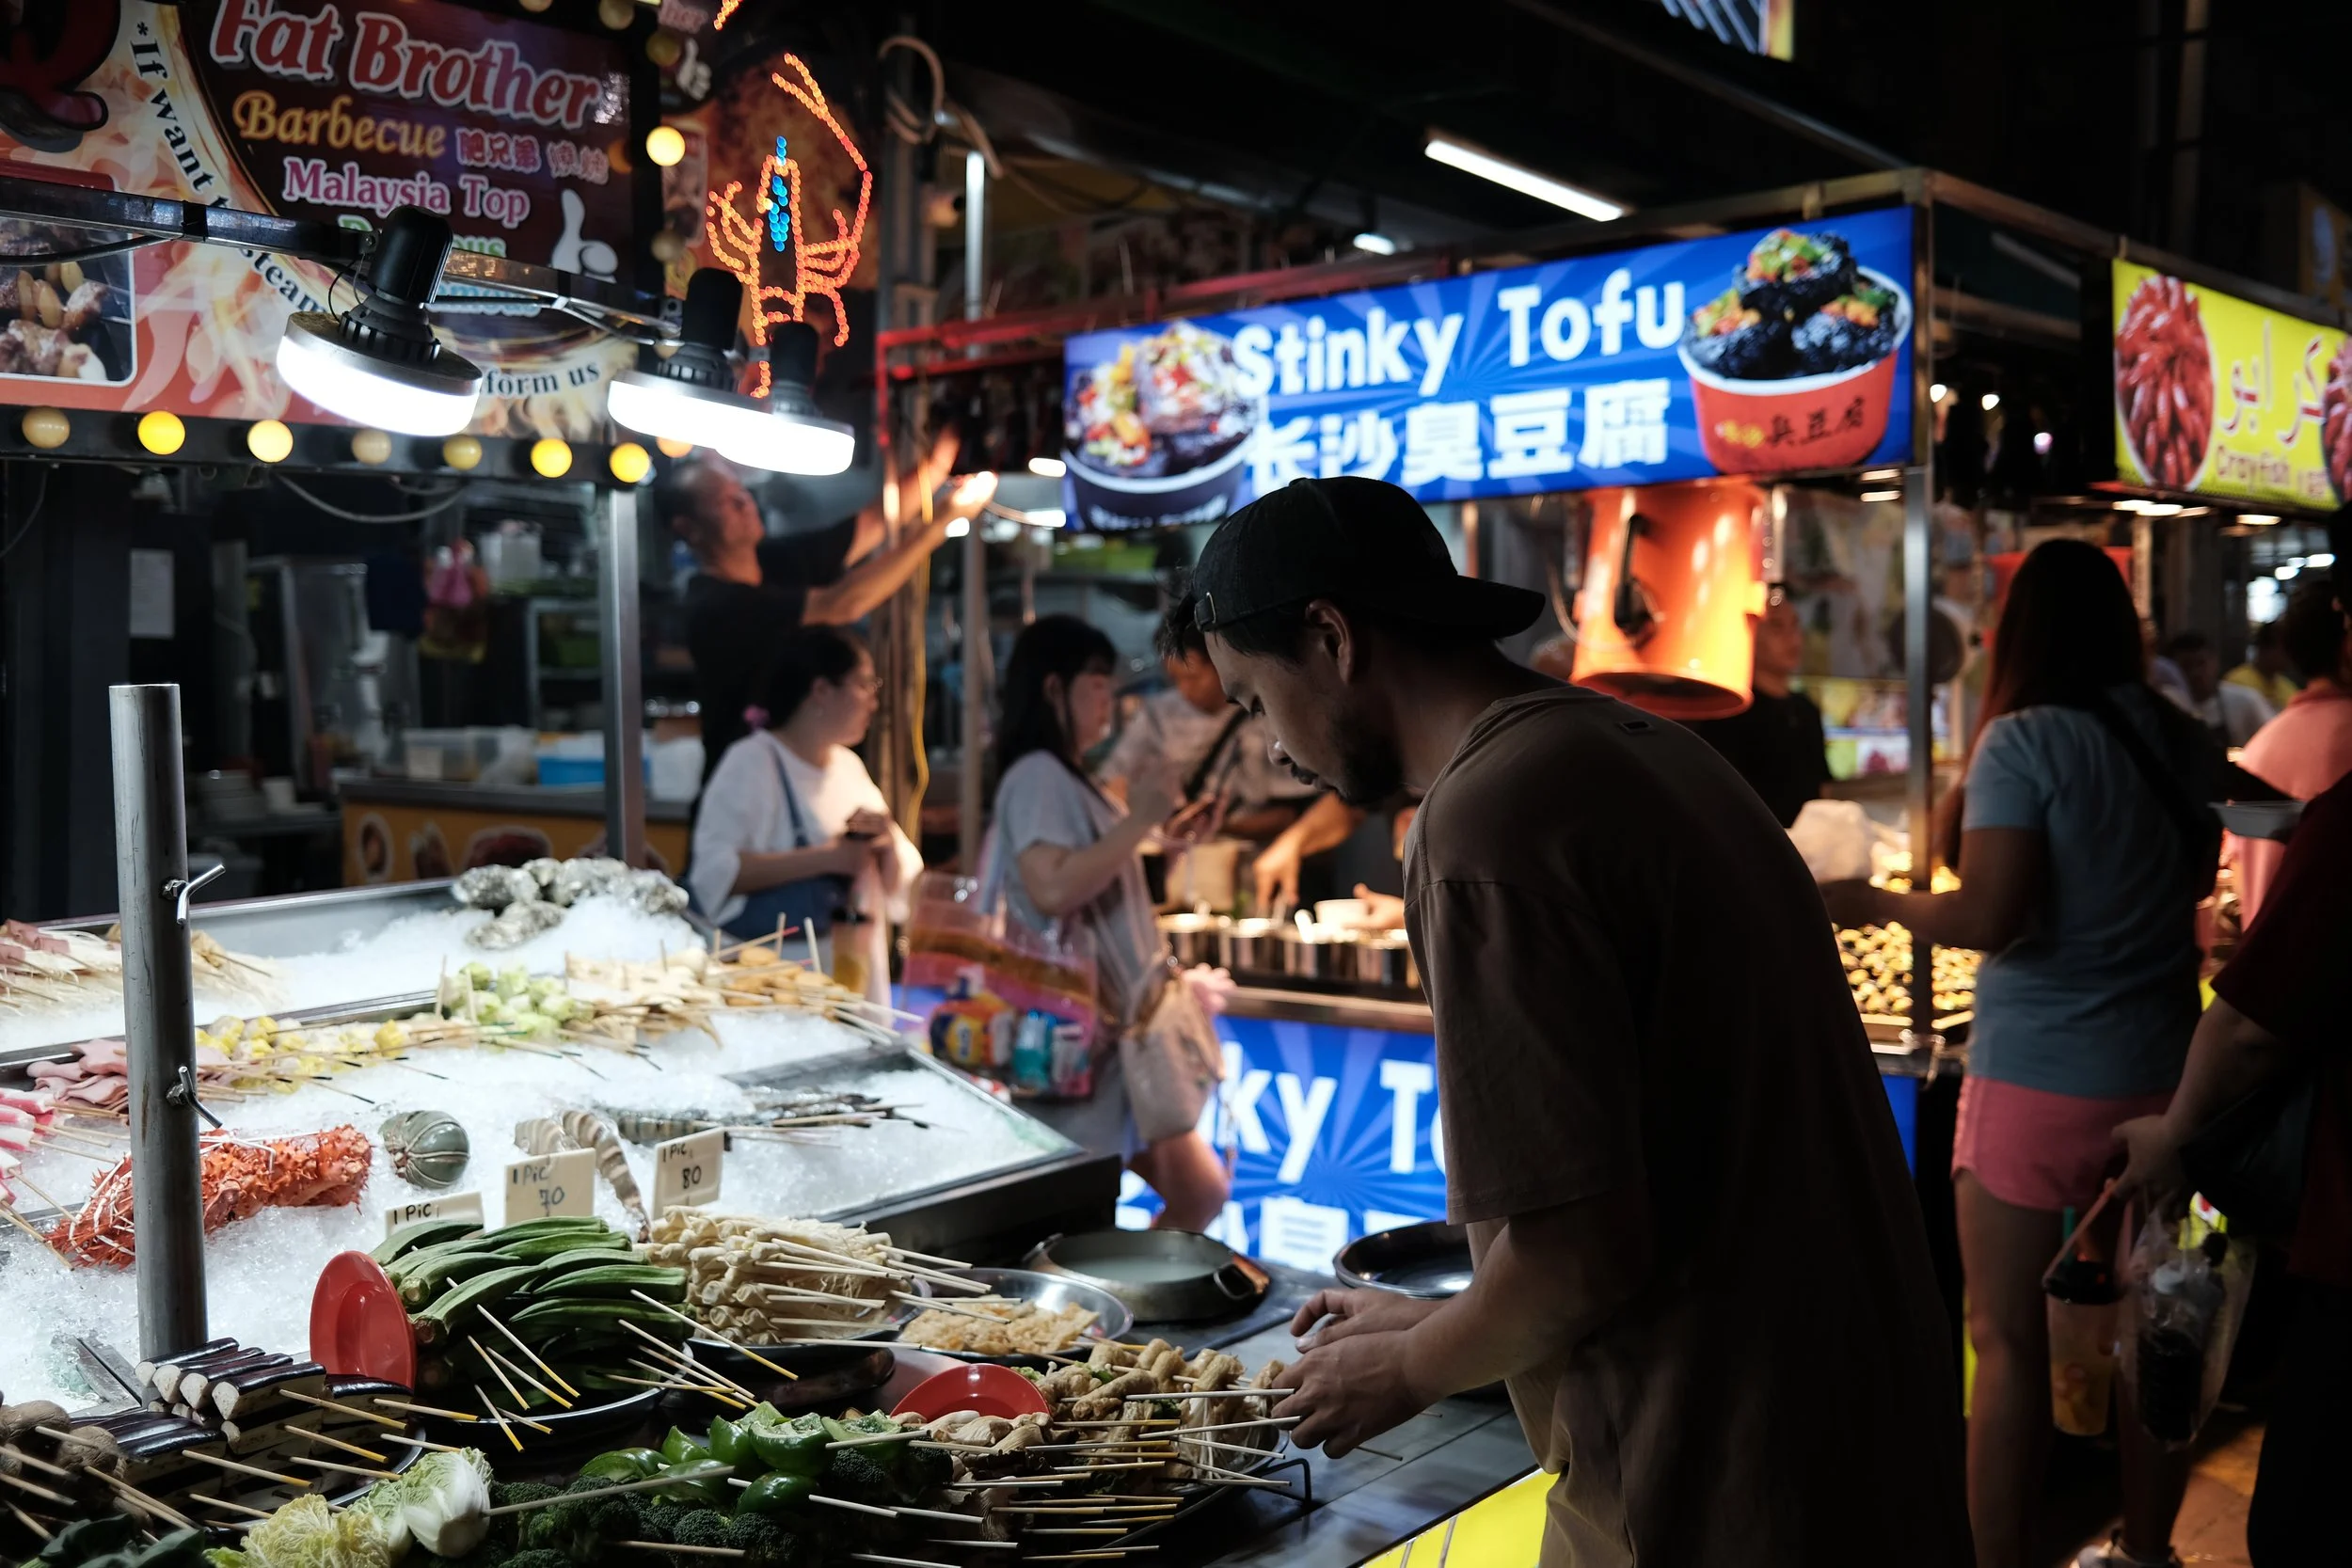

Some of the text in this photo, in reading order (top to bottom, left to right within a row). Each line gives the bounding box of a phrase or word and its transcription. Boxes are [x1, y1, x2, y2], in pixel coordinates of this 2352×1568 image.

[210, 0, 601, 129] Fat Brother
[233, 89, 447, 159] Barbecue
[151, 87, 215, 192] want
[567, 361, 599, 387] us
[282, 156, 531, 229] Malaysia Top
[1232, 267, 1686, 399] Stinky Tofu
[1243, 378, 1672, 499] 长沙臭豆腐
[539, 1185, 565, 1211] 70
[682, 1164, 702, 1190] 80
